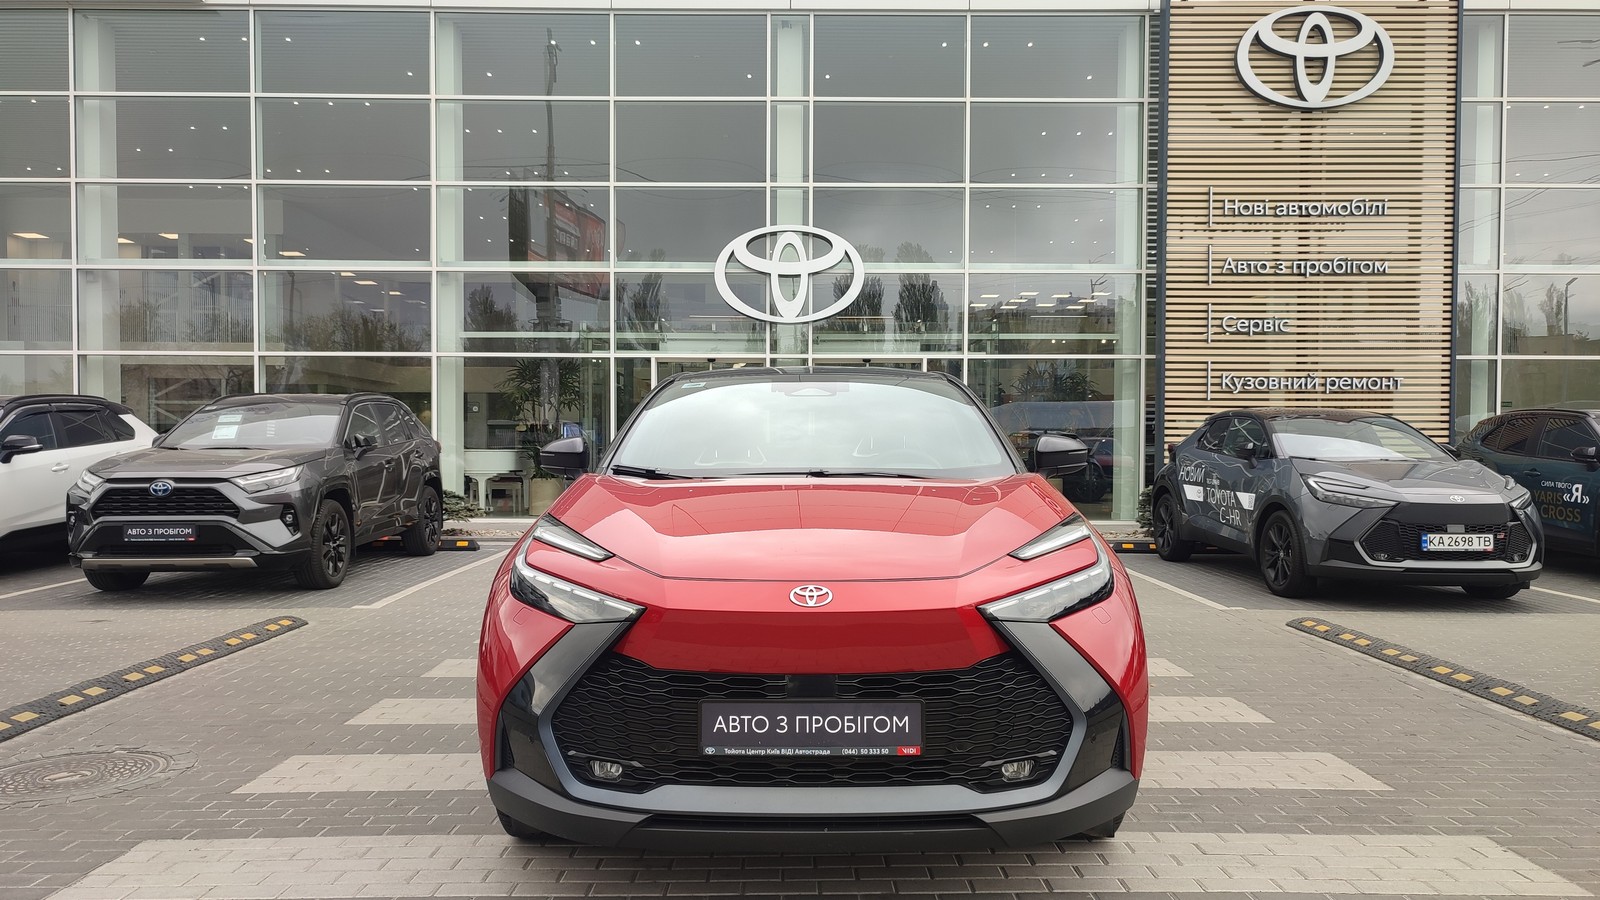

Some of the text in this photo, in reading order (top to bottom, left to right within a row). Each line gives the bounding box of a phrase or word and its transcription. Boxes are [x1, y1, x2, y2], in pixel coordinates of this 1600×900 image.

[1223, 198, 1389, 216] Нові автомобілі
[1222, 256, 1389, 278] Авто з пробігом
[1221, 315, 1291, 336] Сервіс
[1221, 372, 1405, 394] Кузовний ремонт
[1178, 464, 1206, 483] НОВИЙ
[1555, 481, 1572, 489] ТВОГО
[1206, 487, 1236, 507] TOYOTA
[1534, 490, 1563, 504] YARIS
[1220, 507, 1242, 526] C-HR
[1540, 504, 1581, 522] CROSS
[1428, 536, 1492, 547] KA 2698 TB
[713, 715, 909, 734] АВТО З ПРОБІГОМ
[746, 748, 766, 756] Центр
